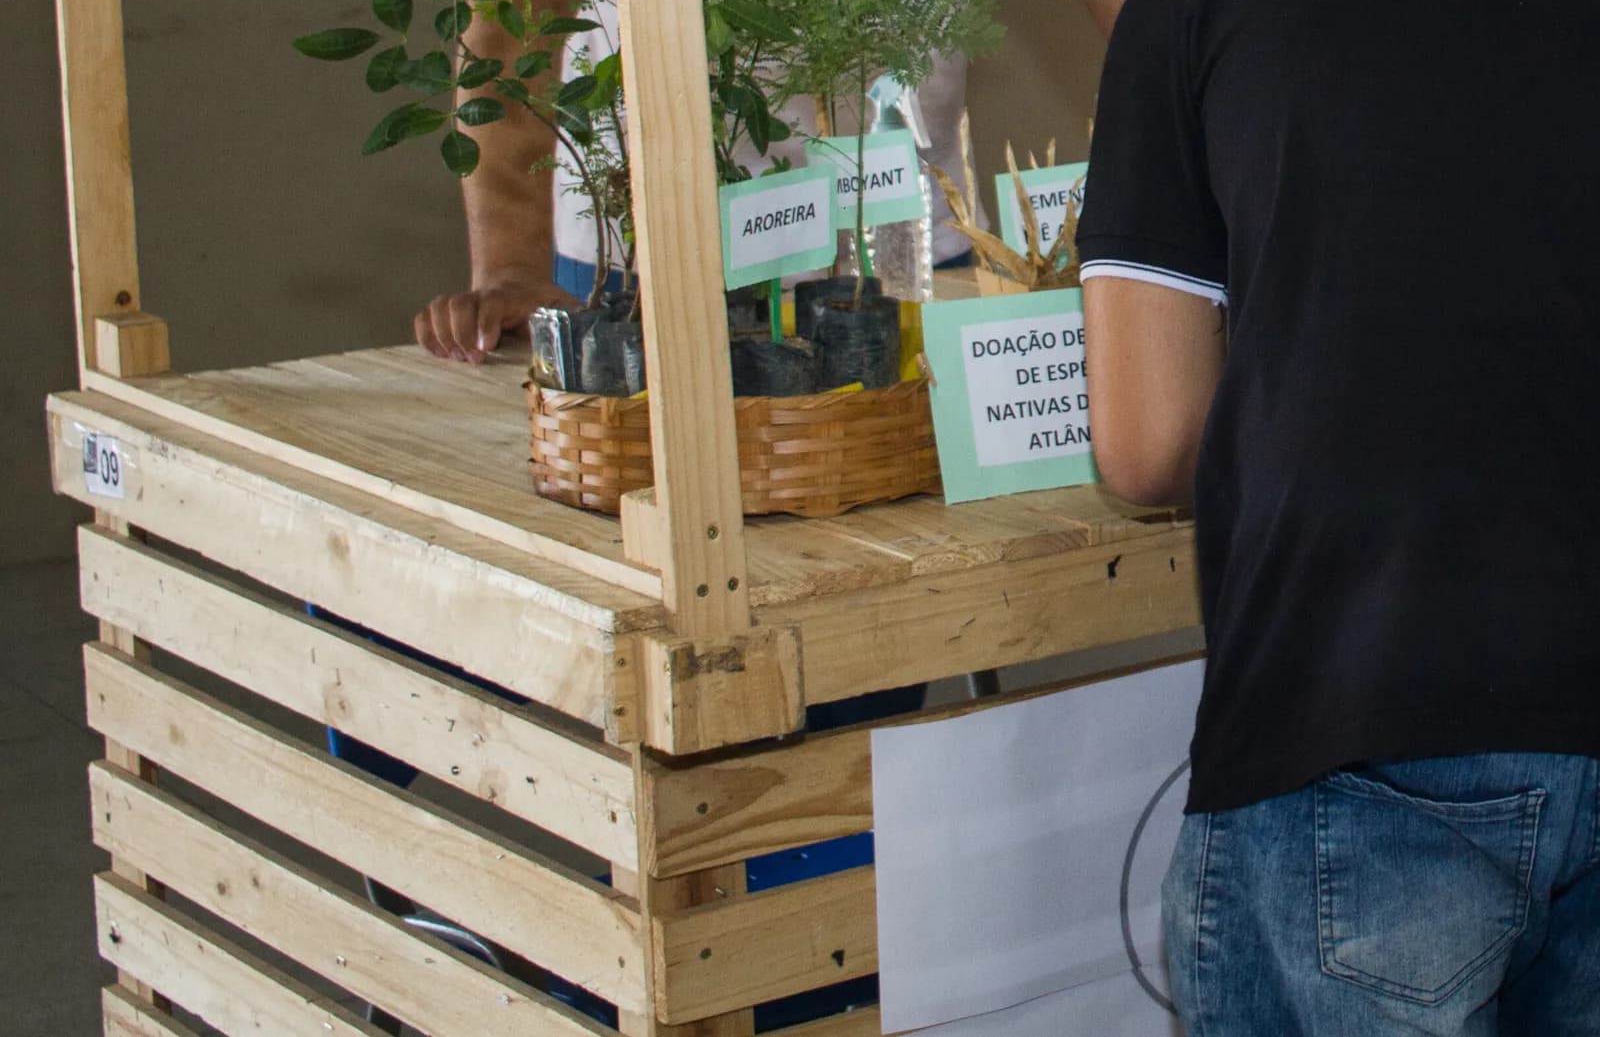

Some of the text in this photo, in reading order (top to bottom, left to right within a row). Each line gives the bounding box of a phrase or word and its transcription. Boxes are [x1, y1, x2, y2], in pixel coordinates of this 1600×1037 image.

[743, 201, 816, 238] AROREIRA
[972, 328, 1086, 358] DOAÇÃO DE
[1016, 367, 1041, 385] DE
[986, 395, 1072, 423] NATIVAS
[100, 448, 120, 487] 09
